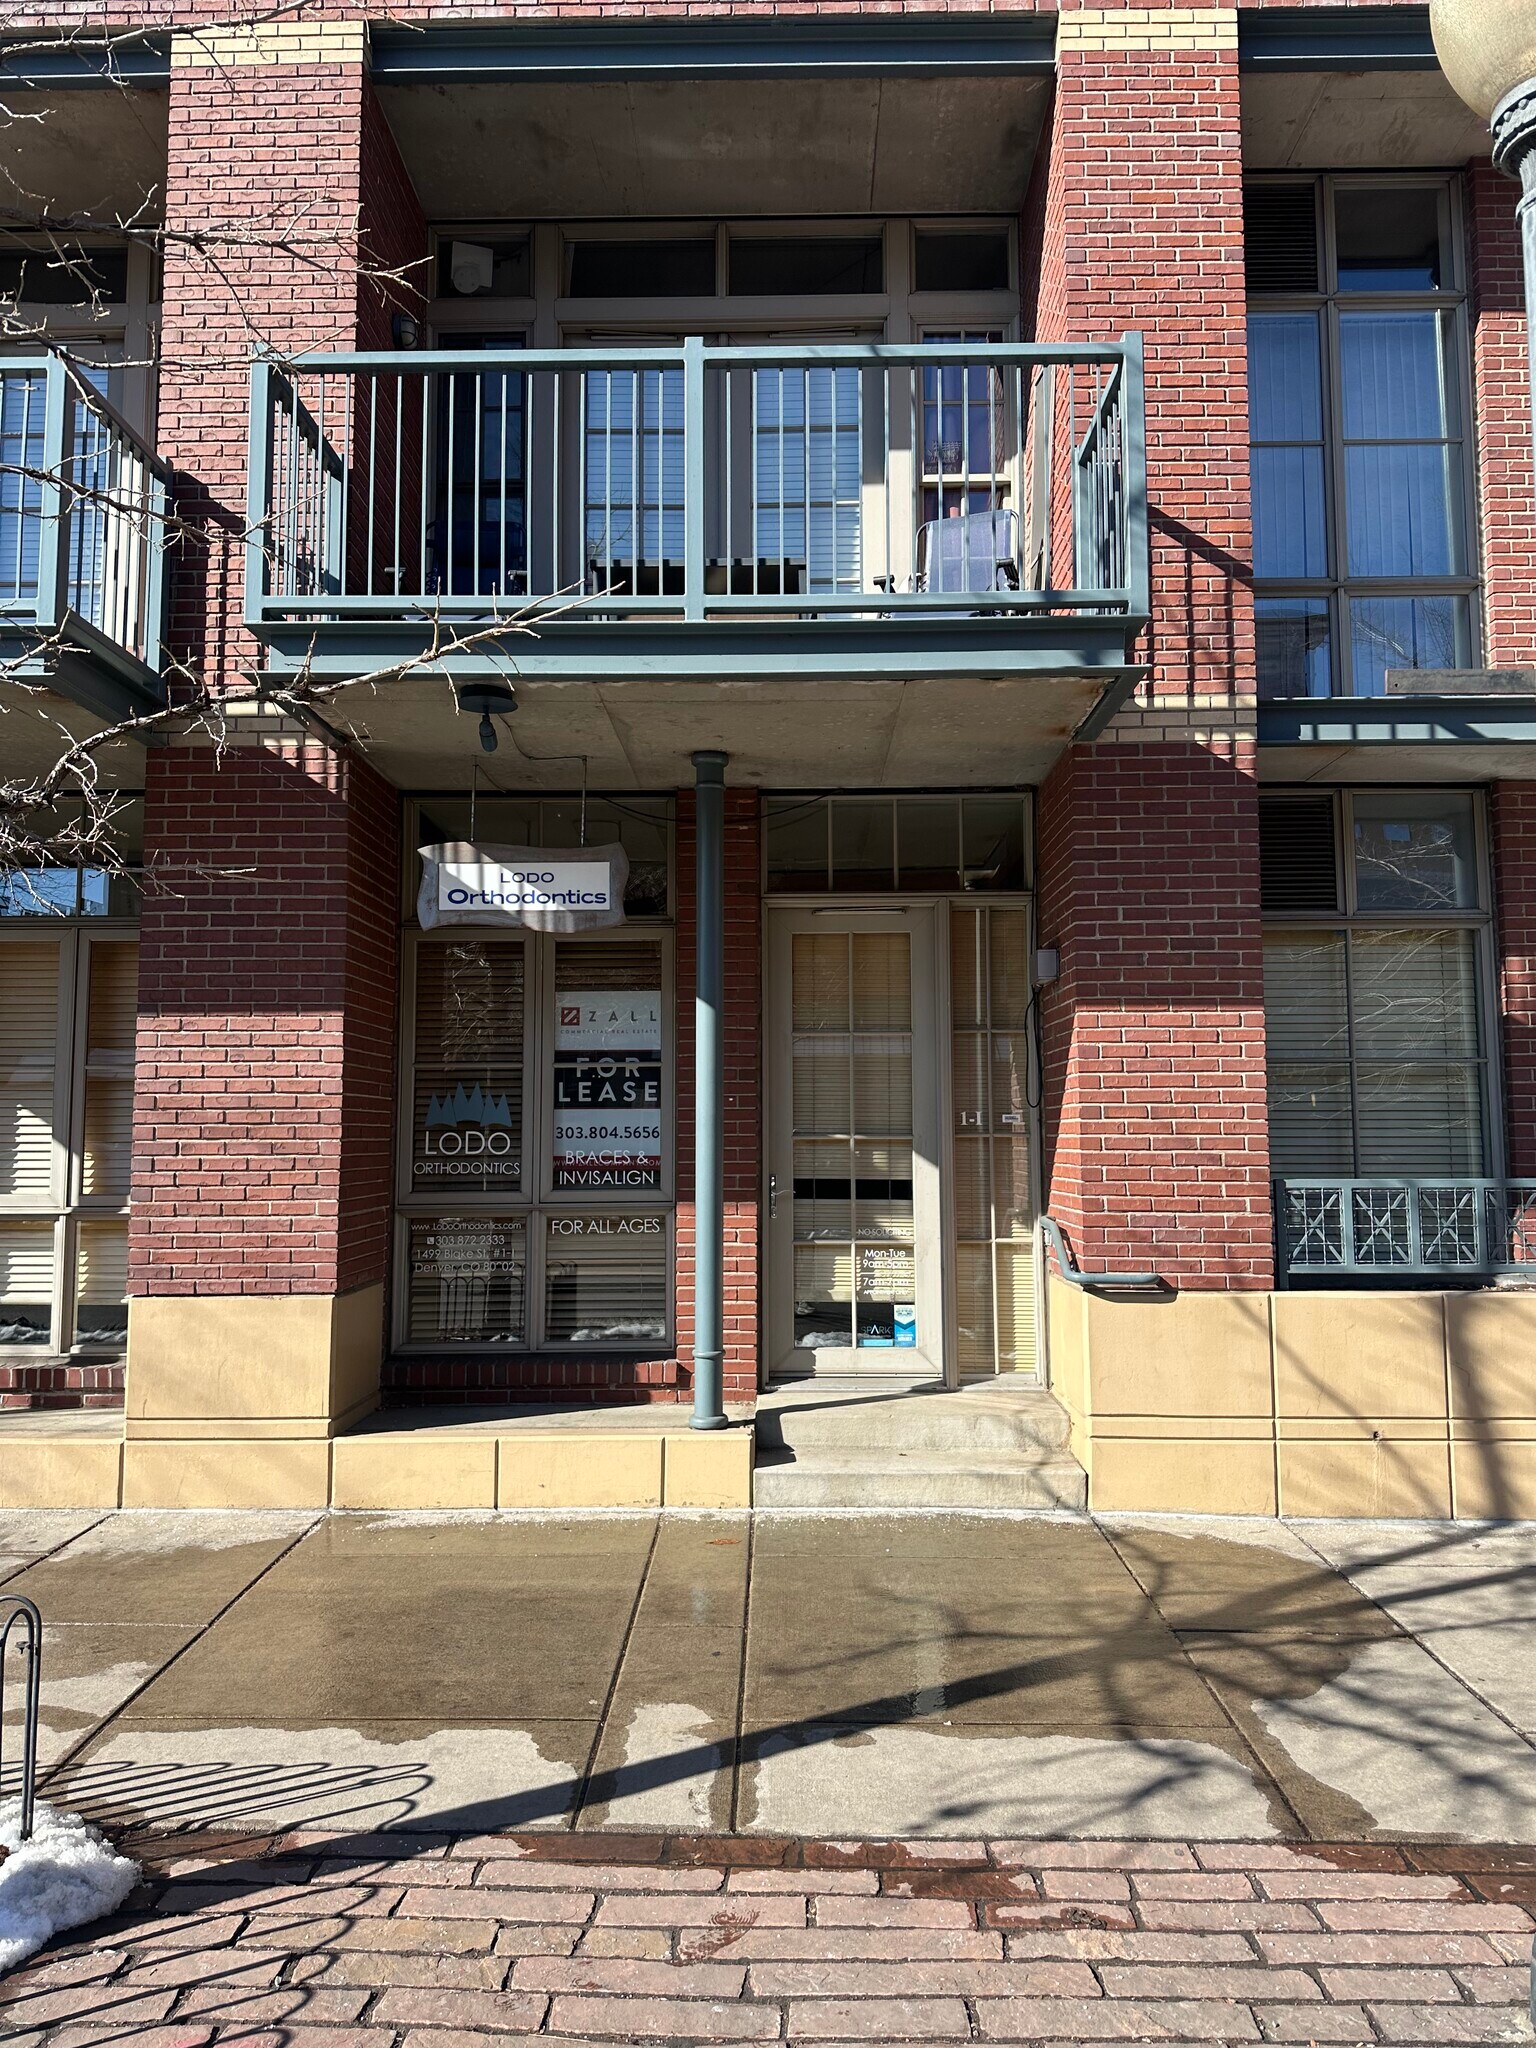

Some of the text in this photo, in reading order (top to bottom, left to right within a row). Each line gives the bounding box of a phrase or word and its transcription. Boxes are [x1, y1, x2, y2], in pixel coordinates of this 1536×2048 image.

[447, 888, 607, 904] Orthodontics
[588, 1010, 657, 1022] ZALL
[576, 1057, 640, 1078] FOR
[558, 1081, 658, 1102] LEASE
[555, 1126, 660, 1139] 303.804.5656
[565, 1150, 649, 1165] BRACES &
[413, 1162, 520, 1175] ORTHODONTICS
[559, 1170, 654, 1185] INVISALIGN
[551, 1218, 660, 1235] FOR ALL AGES
[416, 1249, 441, 1259] 1499
[444, 1248, 474, 1259] Blake
[864, 1248, 906, 1258] Mon-Tue
[461, 1262, 480, 1272] CO
